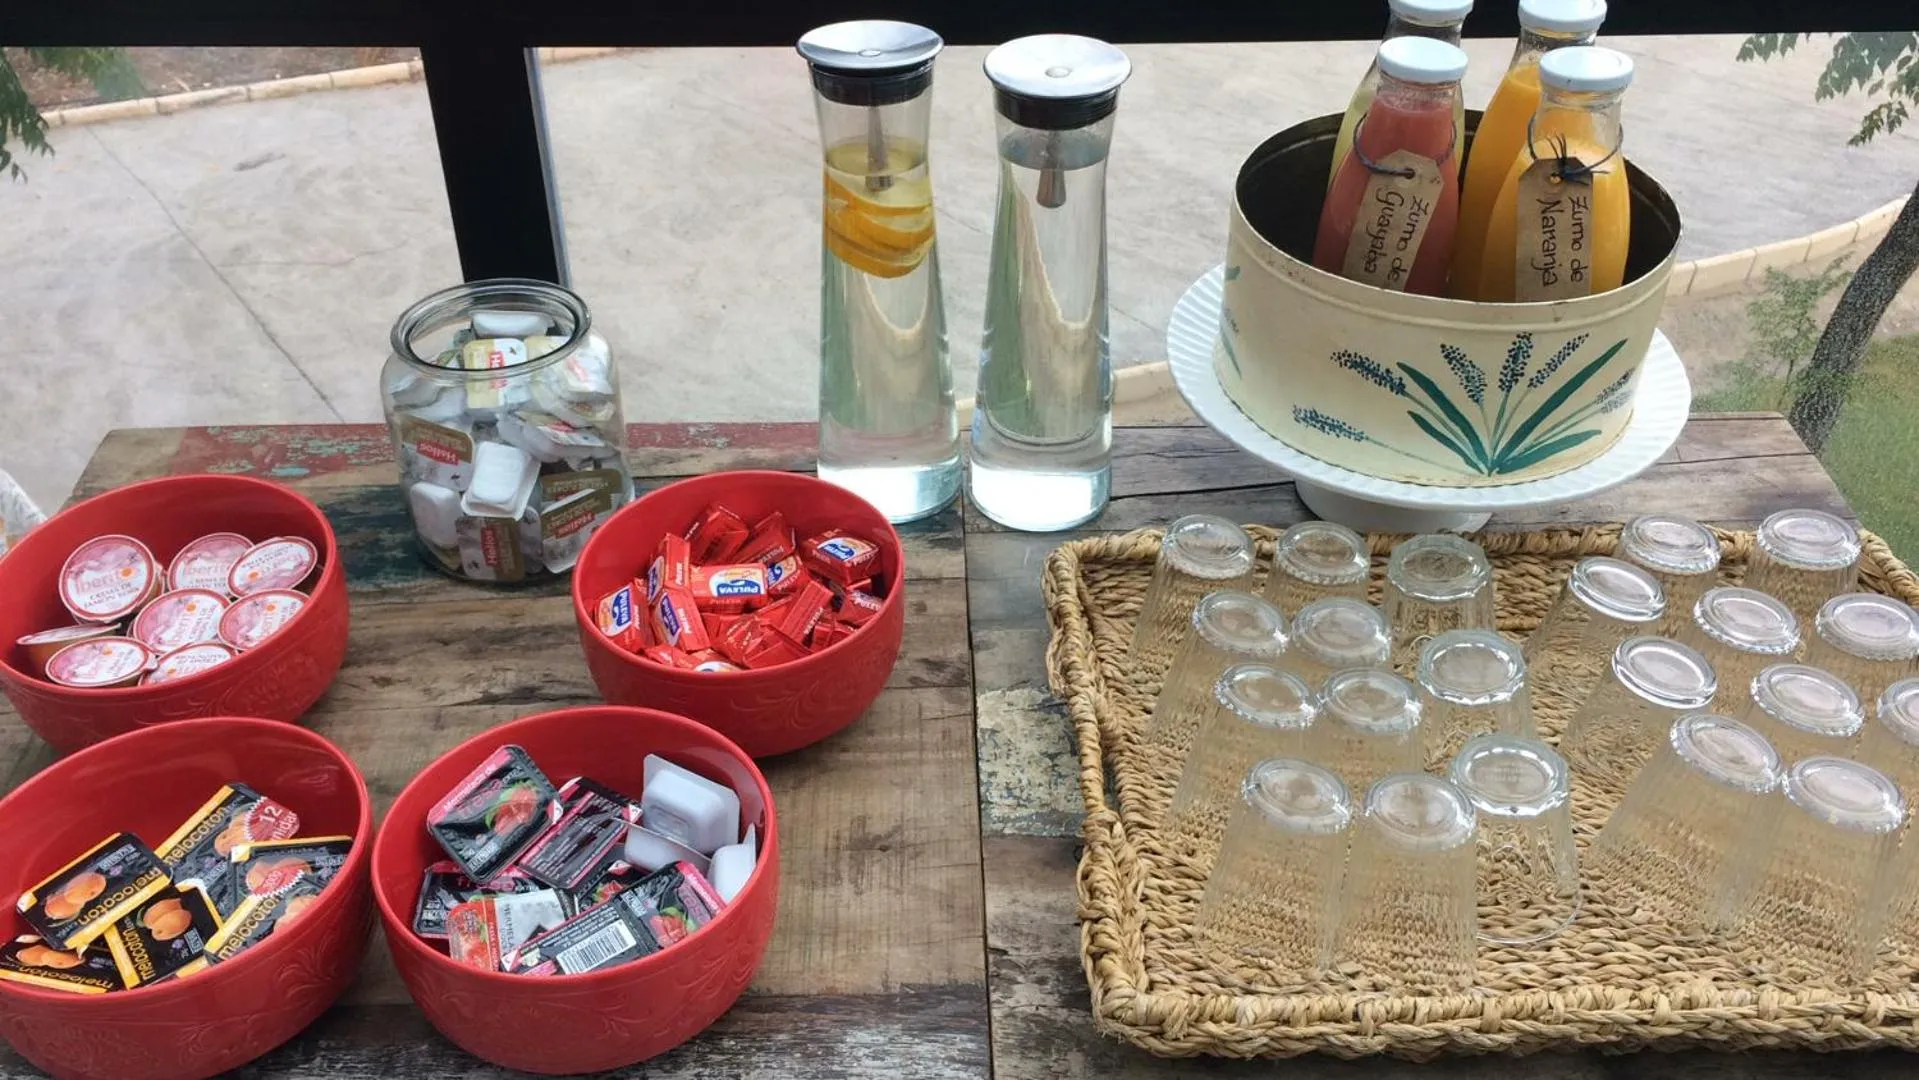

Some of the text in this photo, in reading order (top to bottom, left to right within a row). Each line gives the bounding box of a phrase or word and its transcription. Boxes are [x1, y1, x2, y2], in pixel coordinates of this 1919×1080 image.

[1387, 195, 1429, 281] Zumo de
[1531, 198, 1564, 287] Naranja
[1568, 196, 1588, 282] Zumo de
[619, 590, 629, 625] PULEVA
[718, 585, 759, 595] PULEVA
[260, 805, 282, 823] 12
[79, 867, 162, 925] melocoton
[123, 929, 157, 980] melocoton
